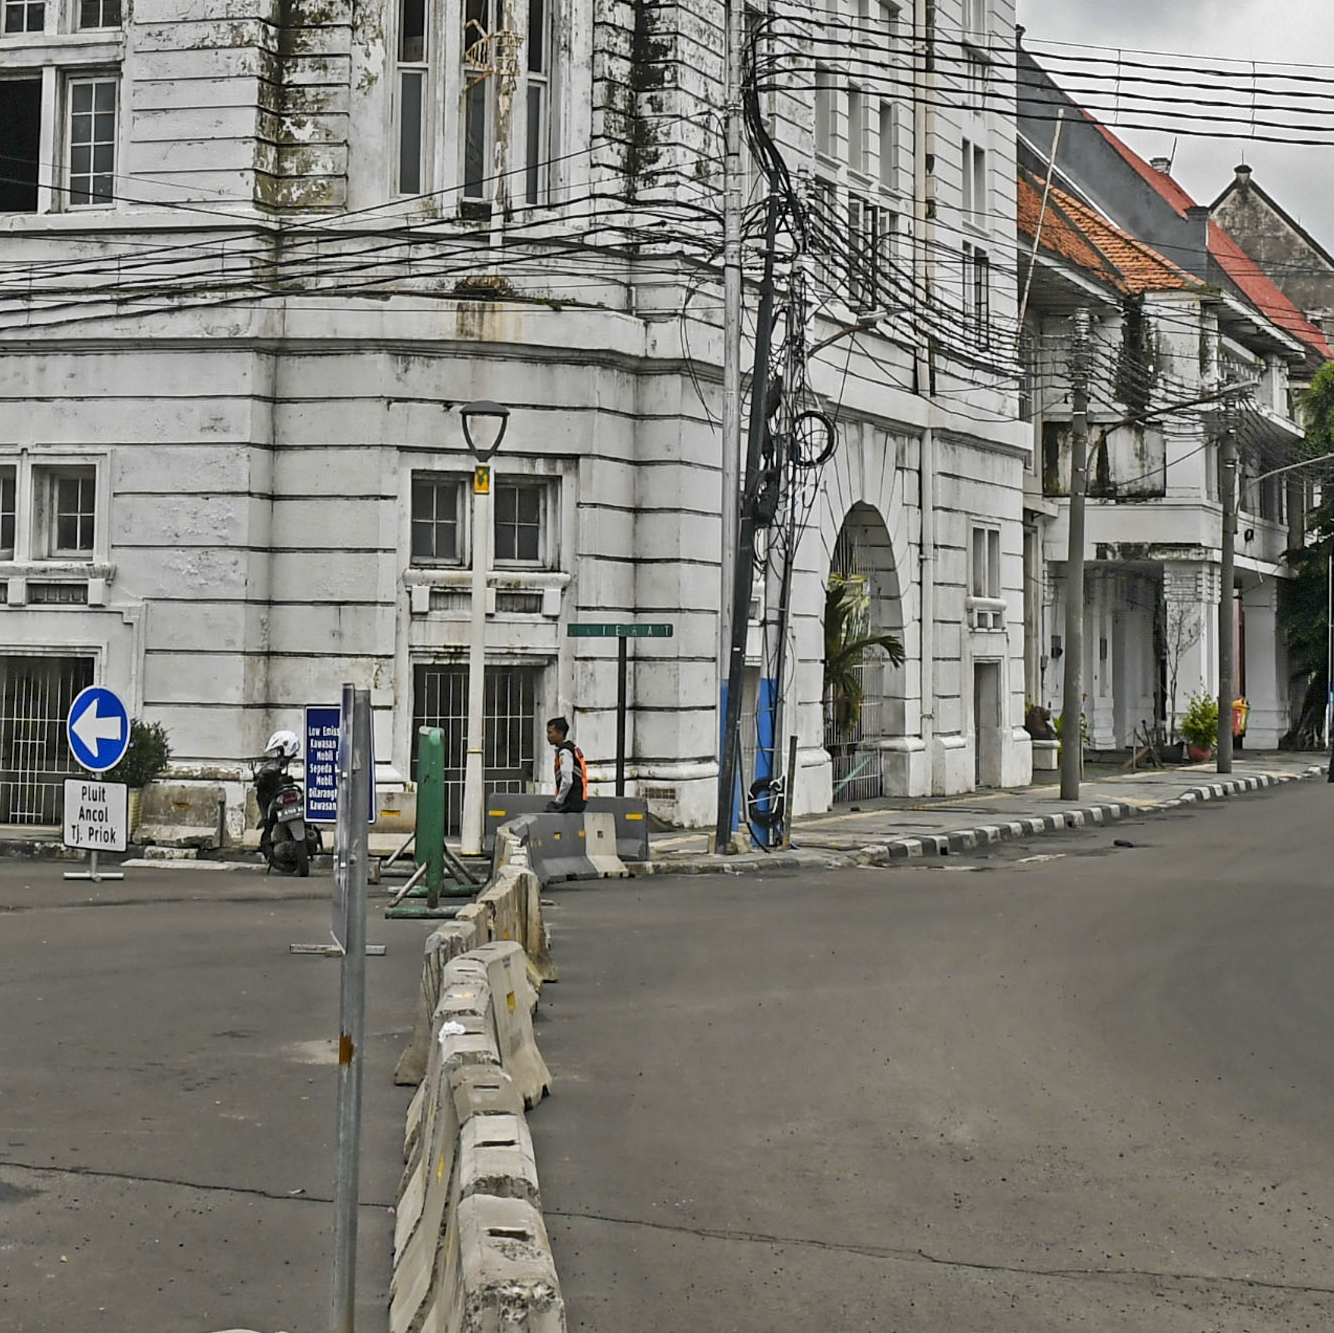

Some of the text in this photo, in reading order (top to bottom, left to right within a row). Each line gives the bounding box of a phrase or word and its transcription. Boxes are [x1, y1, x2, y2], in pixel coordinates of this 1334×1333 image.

[309, 726, 320, 737] Low
[311, 738, 336, 749] Kawasan
[317, 750, 333, 762] Mobil
[310, 762, 332, 775] Sepeda
[316, 775, 333, 786] Mobil
[81, 786, 106, 802] Pluit
[78, 806, 108, 822] Ancol
[71, 824, 116, 844] Tj. Priok
